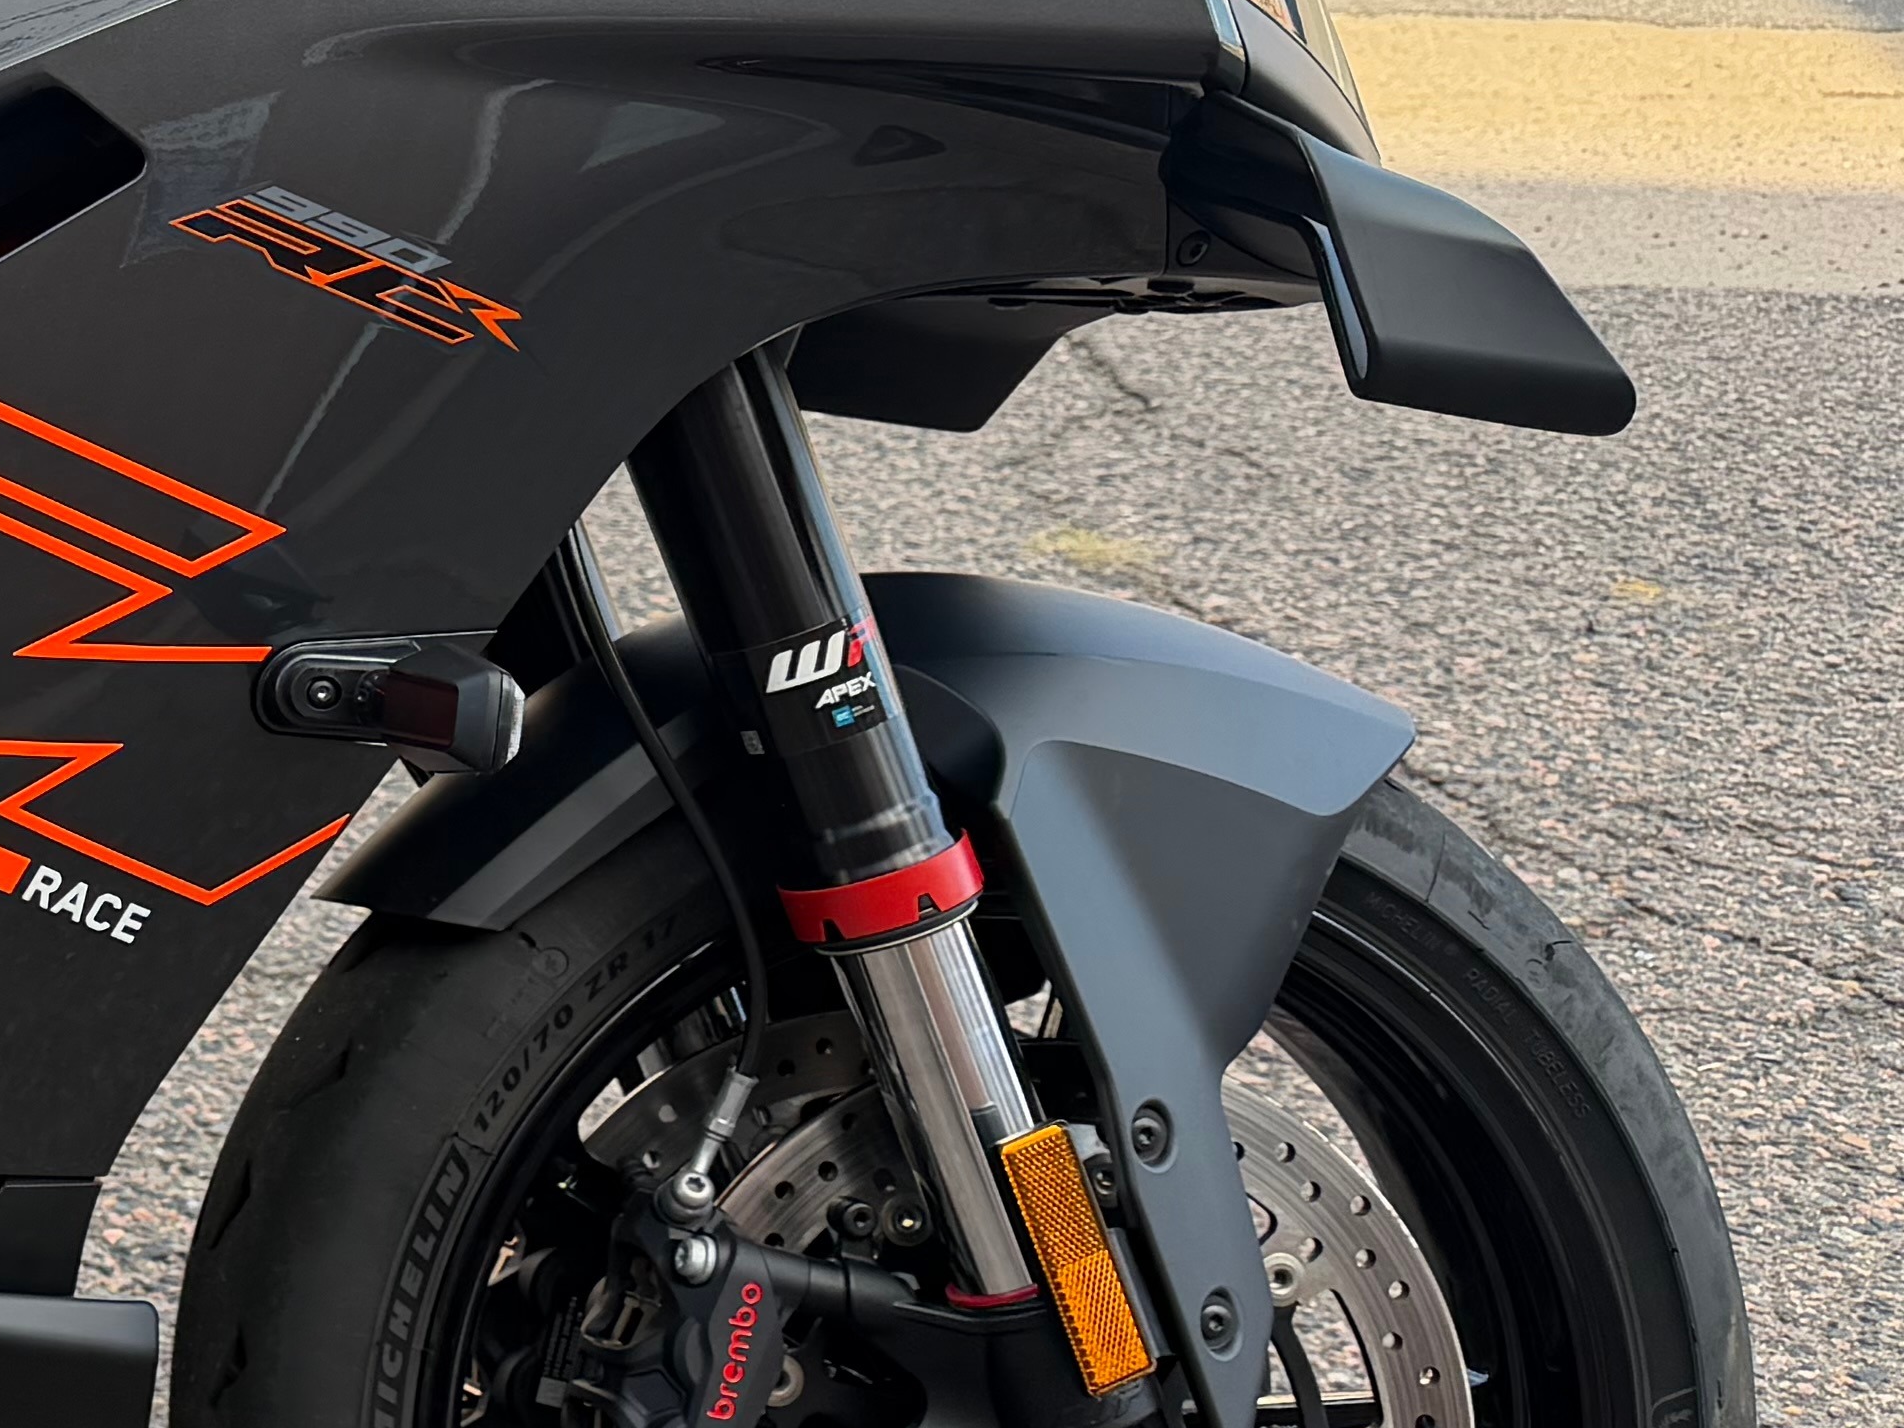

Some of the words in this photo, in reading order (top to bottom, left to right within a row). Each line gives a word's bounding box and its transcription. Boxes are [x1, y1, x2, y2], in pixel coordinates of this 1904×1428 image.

[814, 671, 877, 710] APEX
[21, 864, 152, 945] RACE
[473, 1003, 574, 1133] 120/70
[584, 951, 629, 1002] ZR
[706, 1282, 764, 1421] brembo
